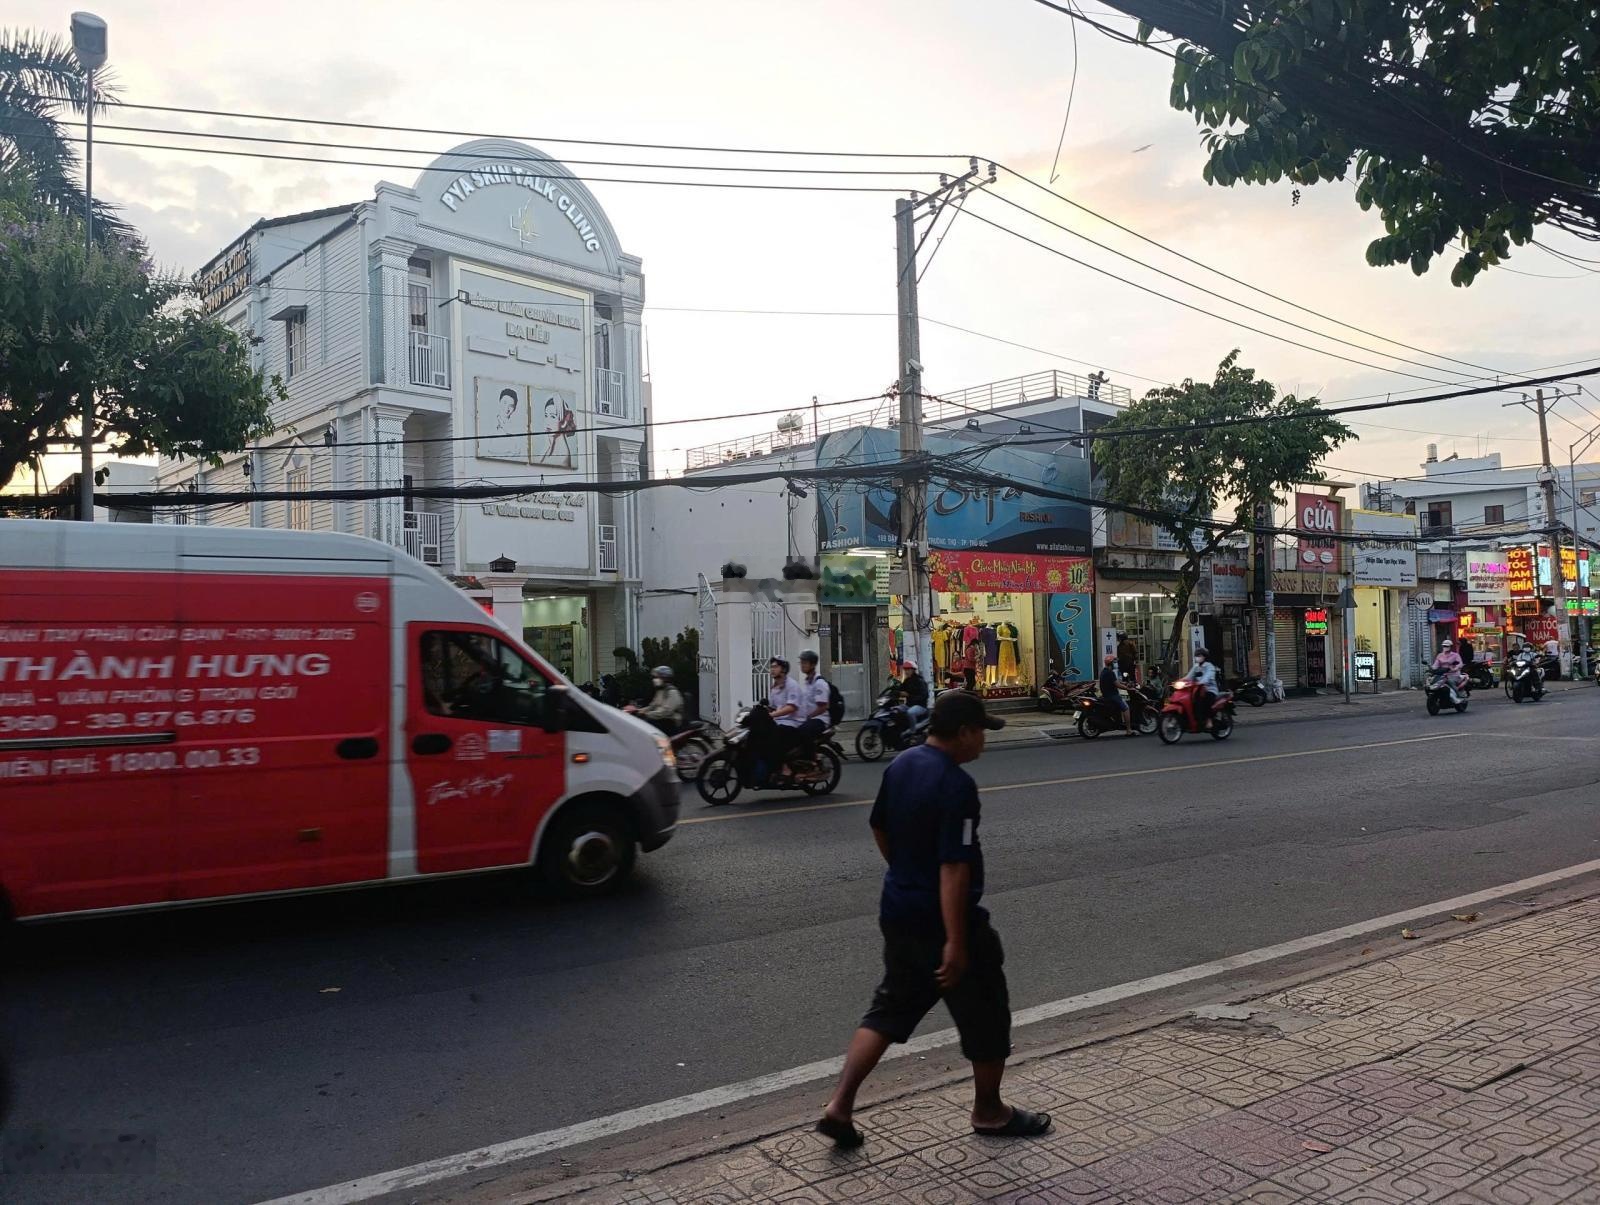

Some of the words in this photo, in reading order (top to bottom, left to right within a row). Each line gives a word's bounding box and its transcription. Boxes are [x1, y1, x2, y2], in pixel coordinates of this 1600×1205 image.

[440, 177, 476, 213] PYA
[470, 164, 513, 189] SKIN
[511, 165, 557, 204] TALK
[556, 193, 601, 253] CLINIC
[505, 321, 526, 340] DA
[1303, 499, 1336, 531] CỬA
[821, 536, 860, 550] FASHION
[1508, 560, 1528, 569] TÓC
[1415, 596, 1431, 606] NAIL
[1532, 631, 1551, 641] NAM
[0, 650, 177, 681] THÀNH
[186, 653, 331, 678] HƯNG
[1355, 656, 1374, 667] QUEEN
[107, 747, 261, 772] 1800.00.33
